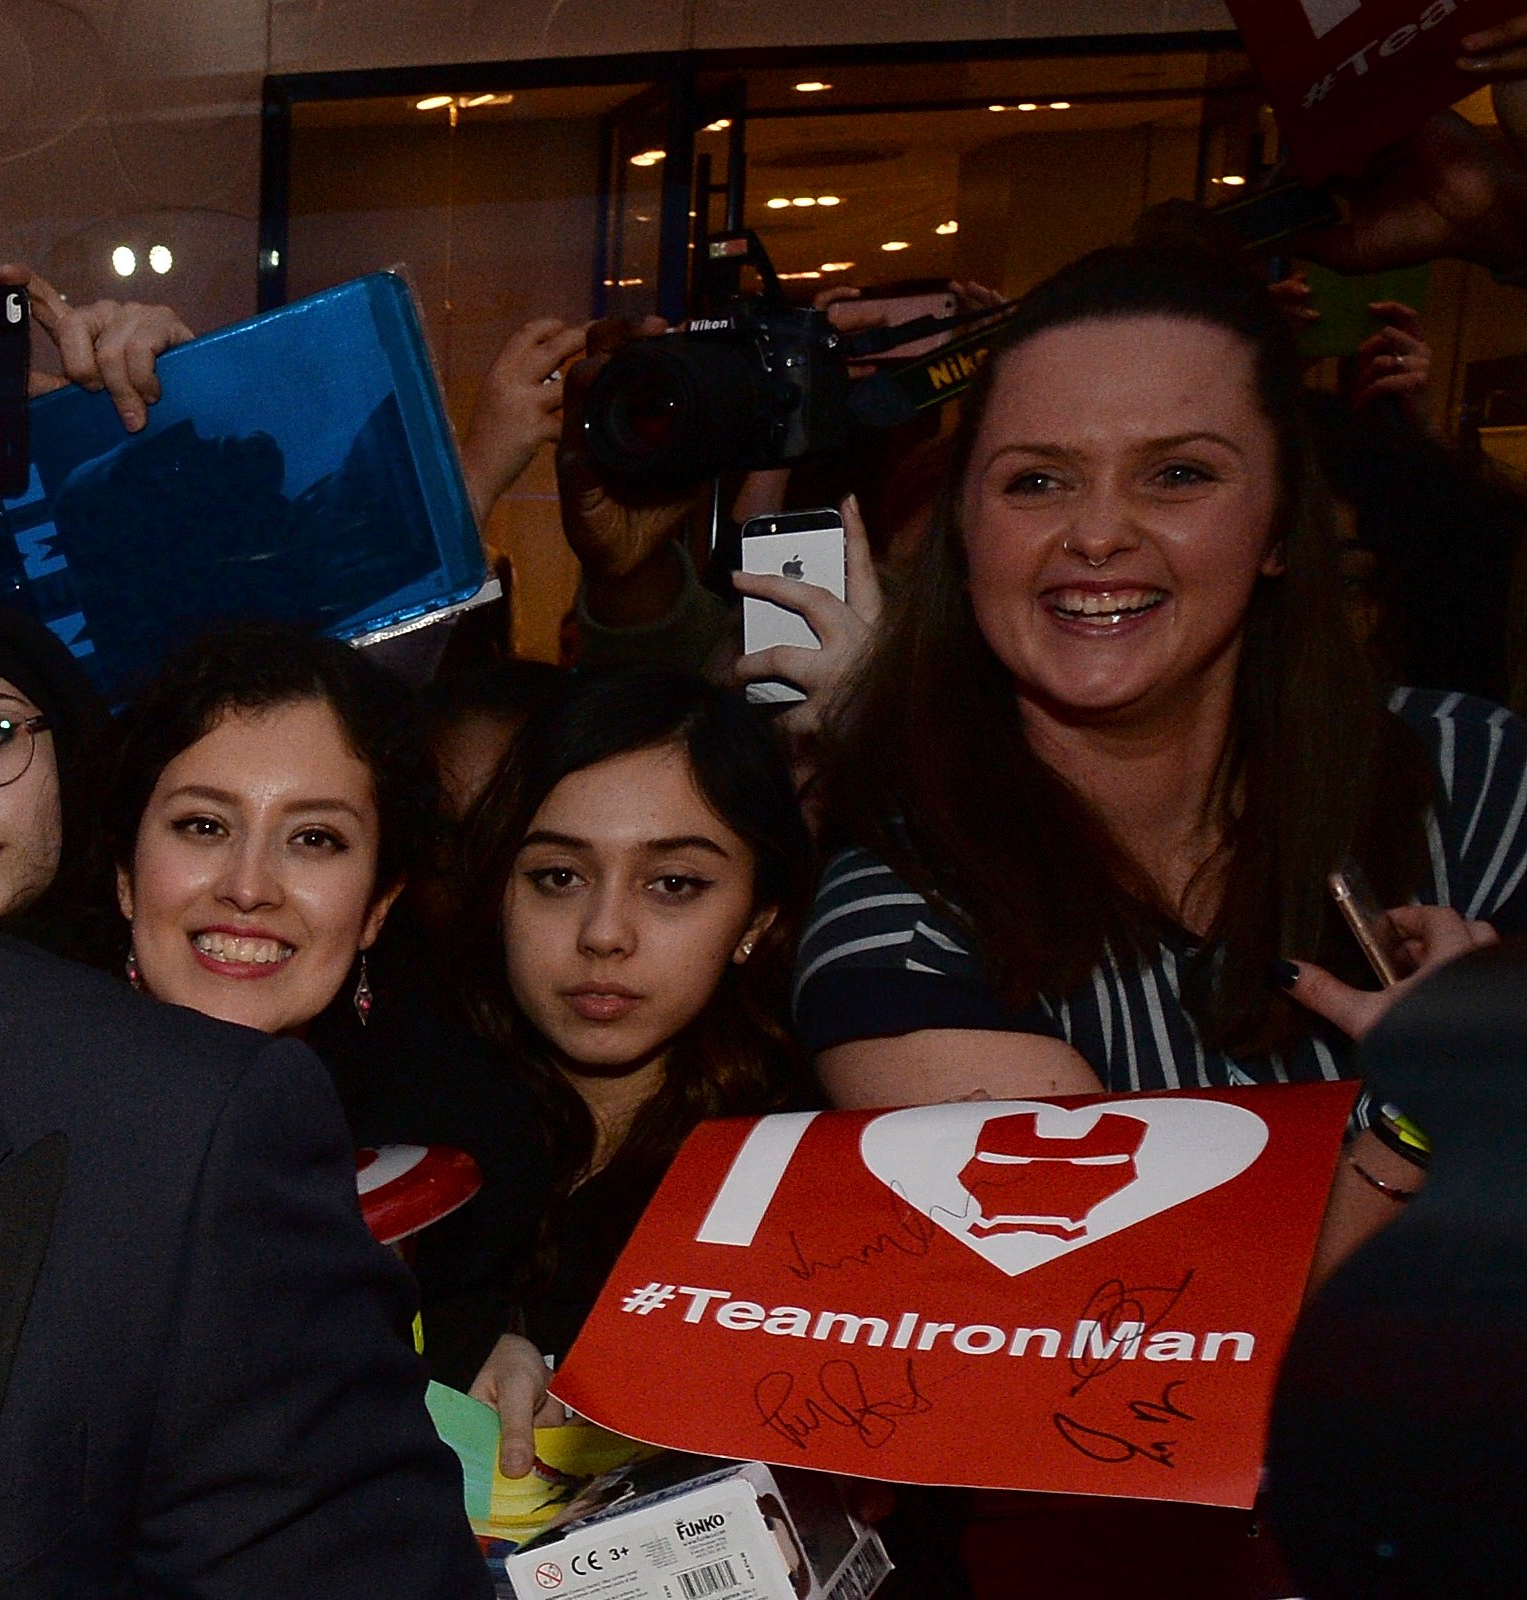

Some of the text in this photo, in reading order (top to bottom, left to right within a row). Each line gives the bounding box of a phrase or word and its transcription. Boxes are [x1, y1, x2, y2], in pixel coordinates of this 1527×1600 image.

[690, 319, 728, 333] Nikon
[696, 1110, 821, 1246] I
[620, 1280, 1256, 1363] #TeamIronMan
[676, 1511, 725, 1542] FUNKO
[609, 1546, 630, 1562] 3+
